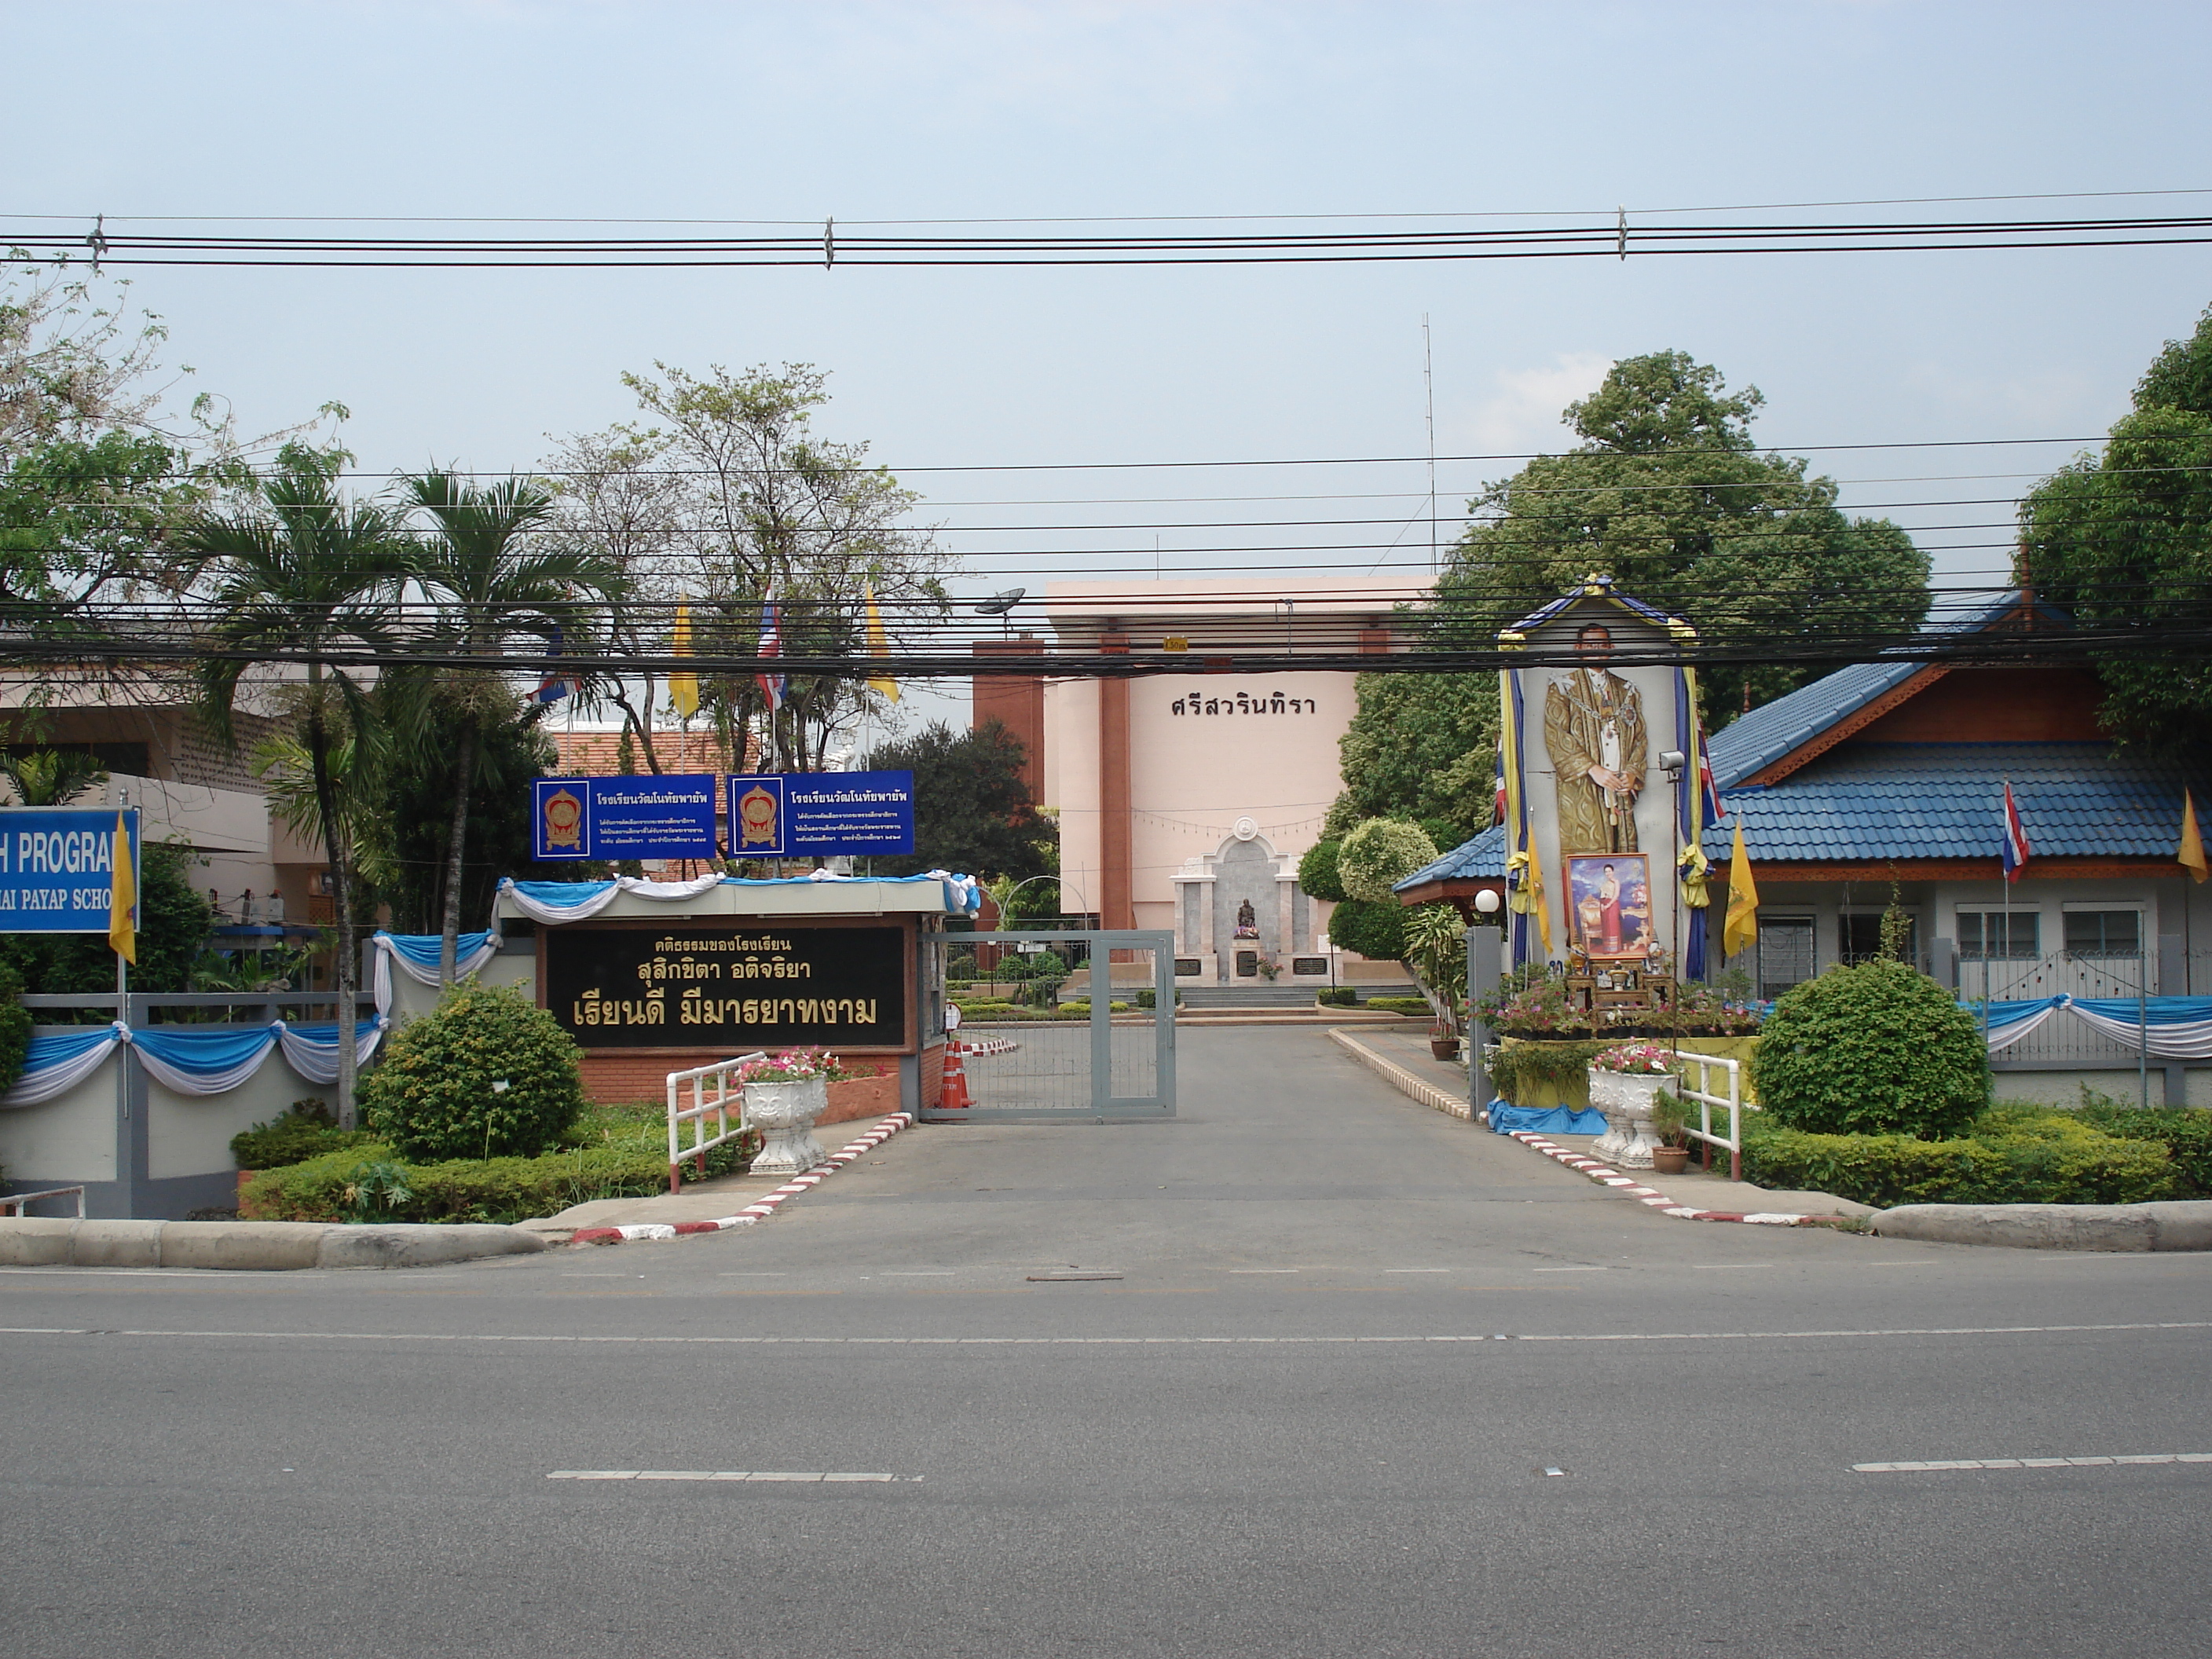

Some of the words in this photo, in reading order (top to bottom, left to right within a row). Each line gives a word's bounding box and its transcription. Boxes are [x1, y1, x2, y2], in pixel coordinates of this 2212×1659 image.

[1172, 691, 1316, 716] ศรีสวรินทิรา
[596, 791, 708, 805] โรงเรียนวัฒโนทัยพายัพ
[790, 789, 907, 804] โรงเรียนวัฒโนทัยพายัพ
[0, 889, 16, 910] AI
[21, 888, 68, 910] PAYAP
[72, 888, 113, 910] SCHO
[654, 935, 792, 952] คติธรรมของโรงเรียน
[637, 956, 721, 987] สุสิกขิตา
[731, 955, 811, 980] อติจริยา
[573, 987, 665, 1025] เรียนดี
[680, 987, 877, 1024] มีมารยาทงาม
